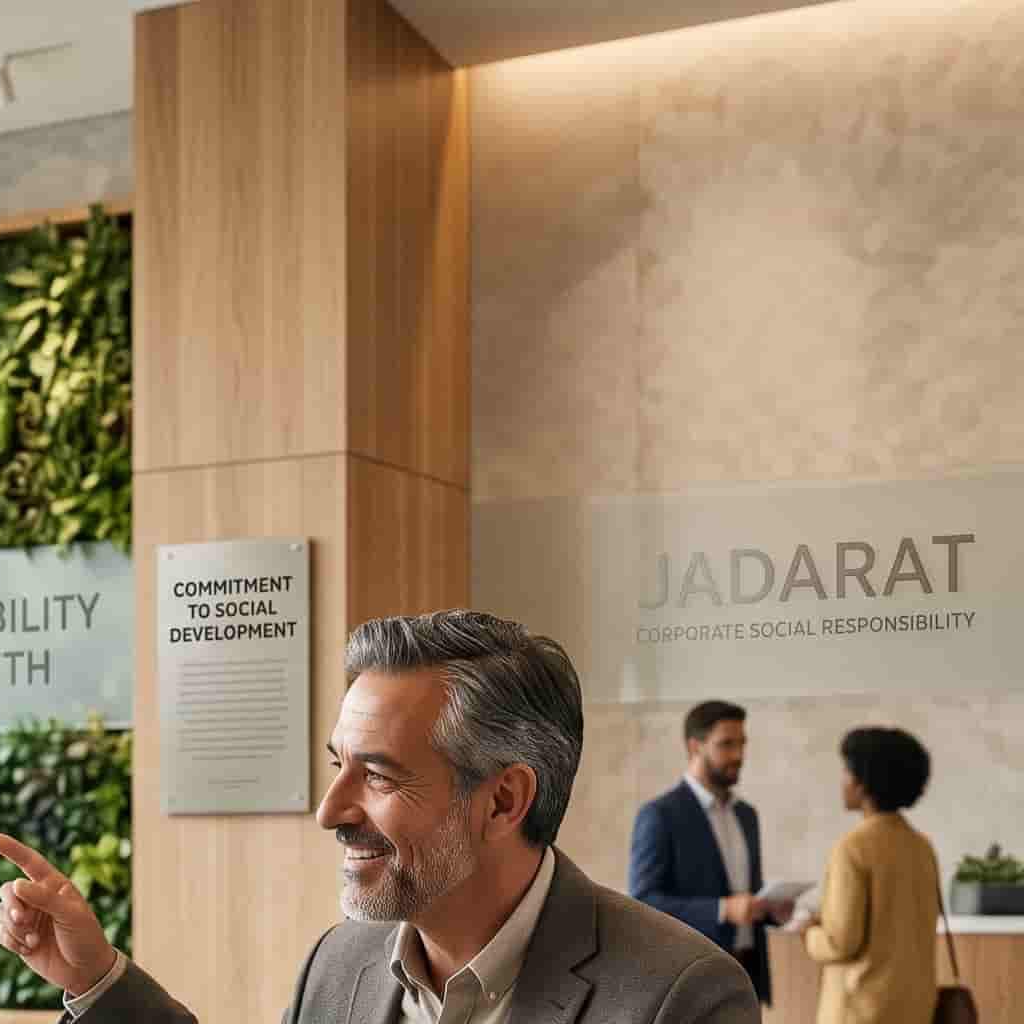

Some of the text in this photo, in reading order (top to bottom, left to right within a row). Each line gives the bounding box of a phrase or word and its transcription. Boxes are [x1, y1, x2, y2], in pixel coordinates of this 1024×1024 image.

[638, 534, 975, 609] JADARAT
[173, 575, 293, 597] COMMITMENT
[187, 599, 278, 619] TO SOCIAL
[169, 621, 297, 643] DEVELOPMENT
[636, 611, 976, 645] CORPORATE SOCIAL RESPONSIBILITY
